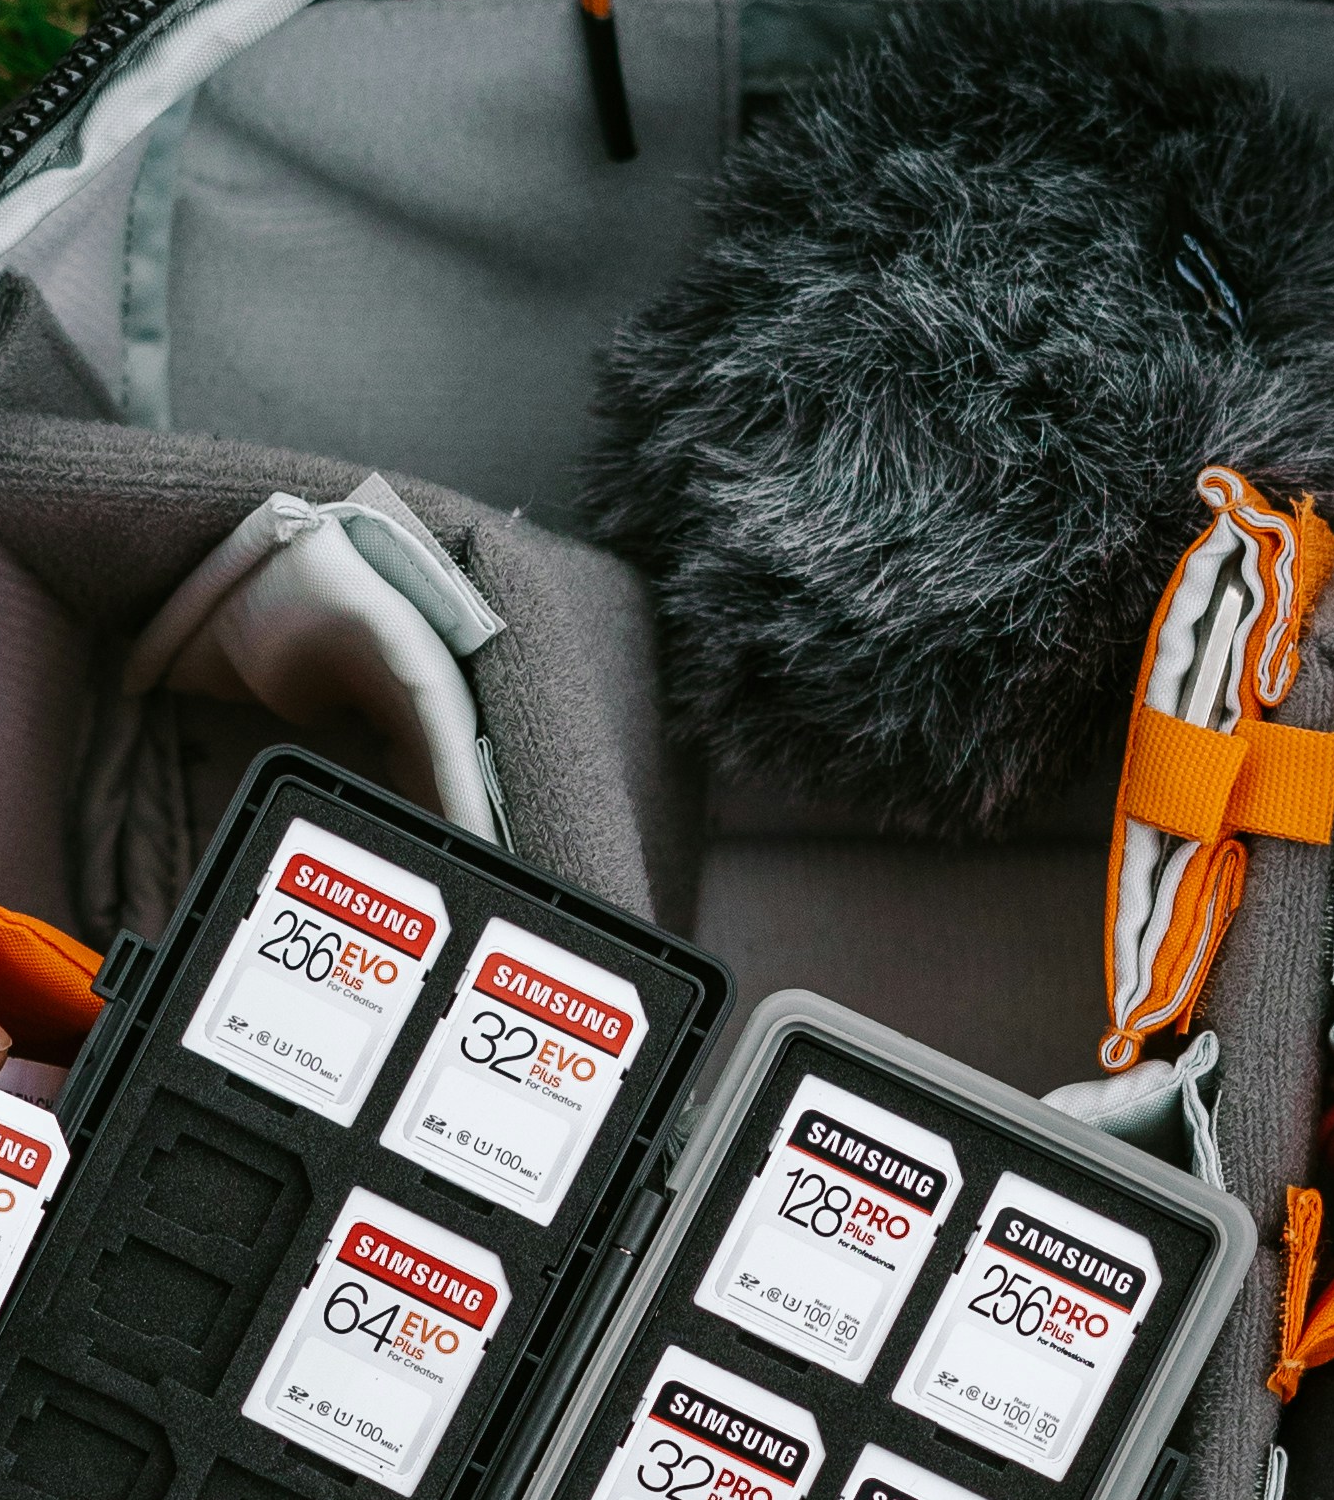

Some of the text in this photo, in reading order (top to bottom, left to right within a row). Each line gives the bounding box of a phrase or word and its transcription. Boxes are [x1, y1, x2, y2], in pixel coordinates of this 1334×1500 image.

[294, 864, 423, 941] SAMSUNG
[258, 910, 398, 984] 256 EVO
[331, 967, 363, 991] Plus
[326, 981, 383, 1014] For Creators
[492, 964, 622, 1040] SAMSUNG
[295, 1048, 322, 1072] 100
[460, 1011, 596, 1083] 32 EVO
[530, 1064, 562, 1088] Plus
[525, 1079, 582, 1111] For Creators
[495, 1148, 521, 1170] 100
[807, 1122, 935, 1197] SAMSUNG
[777, 1168, 910, 1239] 128 PRO
[843, 1221, 875, 1247] Plus
[838, 1238, 895, 1271] For Professionals
[1005, 1220, 1134, 1294] SAMSUNG
[355, 1235, 483, 1312] SAMSUNG
[323, 1282, 459, 1354] 64 EVO
[968, 1264, 1109, 1338] 256 PRO
[804, 1304, 830, 1327] 100
[835, 1321, 857, 1340] 90
[1041, 1320, 1074, 1345] Plus
[393, 1336, 425, 1361] Plus
[1037, 1336, 1095, 1369] For Professionals
[387, 1351, 444, 1384] For Creators
[356, 1419, 383, 1442] 100
[669, 1393, 797, 1468] SAMSUNG
[1003, 1402, 1030, 1425] 100
[1034, 1418, 1058, 1439] 90
